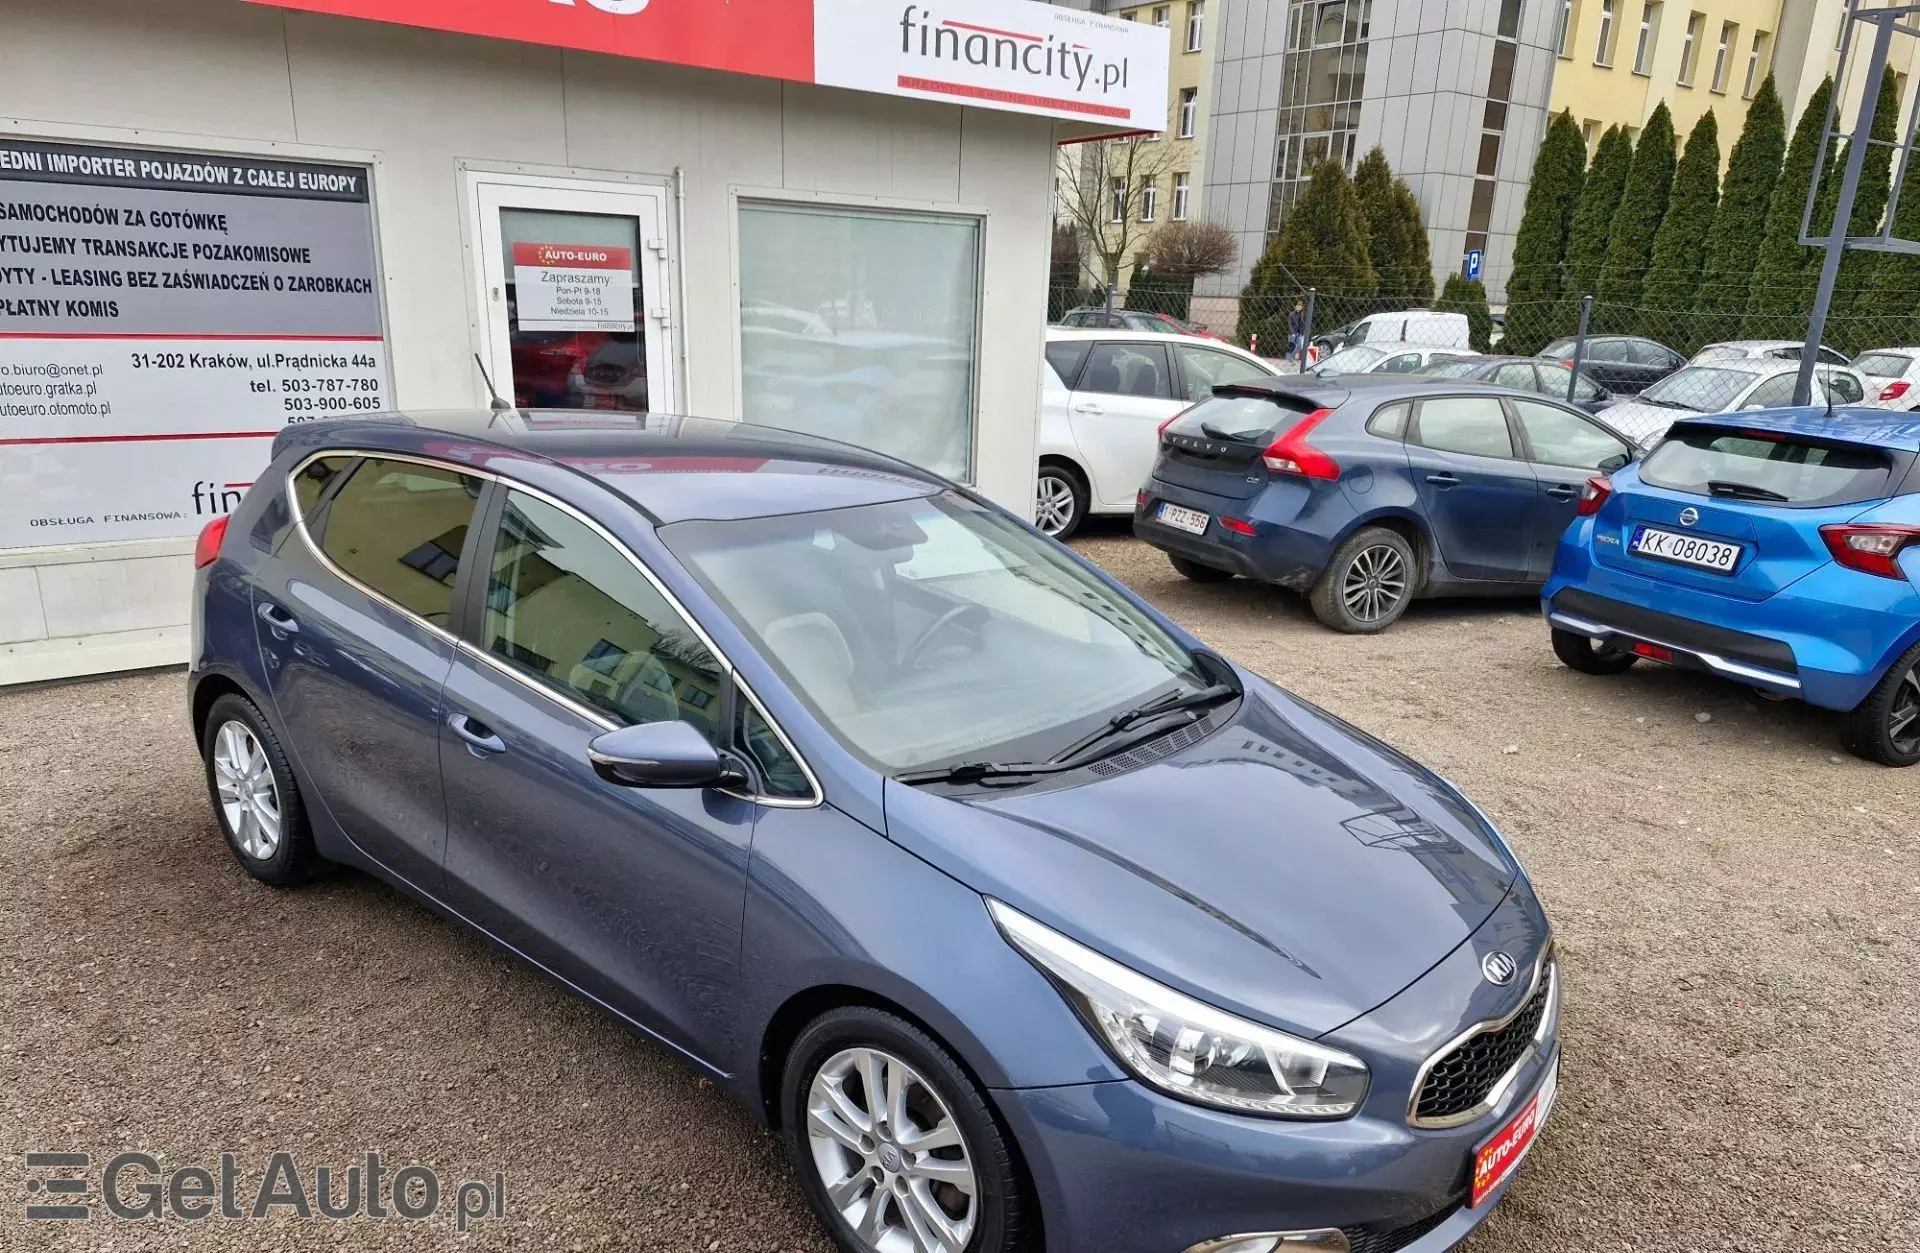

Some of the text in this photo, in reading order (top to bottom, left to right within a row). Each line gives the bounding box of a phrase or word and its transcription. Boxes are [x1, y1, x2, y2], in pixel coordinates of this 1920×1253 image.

[900, 5, 1128, 94] financity.pl
[0, 150, 357, 193] EDNI IMPORTER POJAZDÓW Z CAŁEJ EUROPY
[0, 203, 228, 235] SAMOCHODÓW ZA GOTÓWKĘ
[81, 239, 189, 259] TRANSAKCJE
[193, 244, 311, 264] POZAKOMISOWE
[544, 249, 607, 262] AUTO-EURO
[1470, 252, 1478, 274] P
[0, 267, 36, 285] YTY
[51, 268, 123, 288] LEASING
[128, 271, 158, 289] BEZ
[162, 269, 270, 292] ZAŚWIADCZEŃ
[273, 276, 284, 292] O
[287, 276, 372, 294] ZAROBKACH
[541, 271, 613, 287] Zapraszamy:
[584, 287, 601, 296] 9-18
[66, 301, 119, 318] KOMIS
[557, 296, 602, 306] Sobota 9-15
[551, 306, 609, 316] Niedziela 10-15
[131, 352, 376, 371] 31-202 Kraków, ul.Prądnicka 44a
[250, 378, 378, 393] tel. 503-787-780
[284, 397, 381, 411] 503-900-605
[1172, 437, 1228, 453] VOLVO
[30, 516, 94, 527] OBSŁUGA
[104, 511, 187, 523] FINANSOWA:
[1642, 531, 1733, 566] KK 08038
[1488, 953, 1515, 980] KIA
[1480, 1111, 1535, 1178] AUTO-EURO
